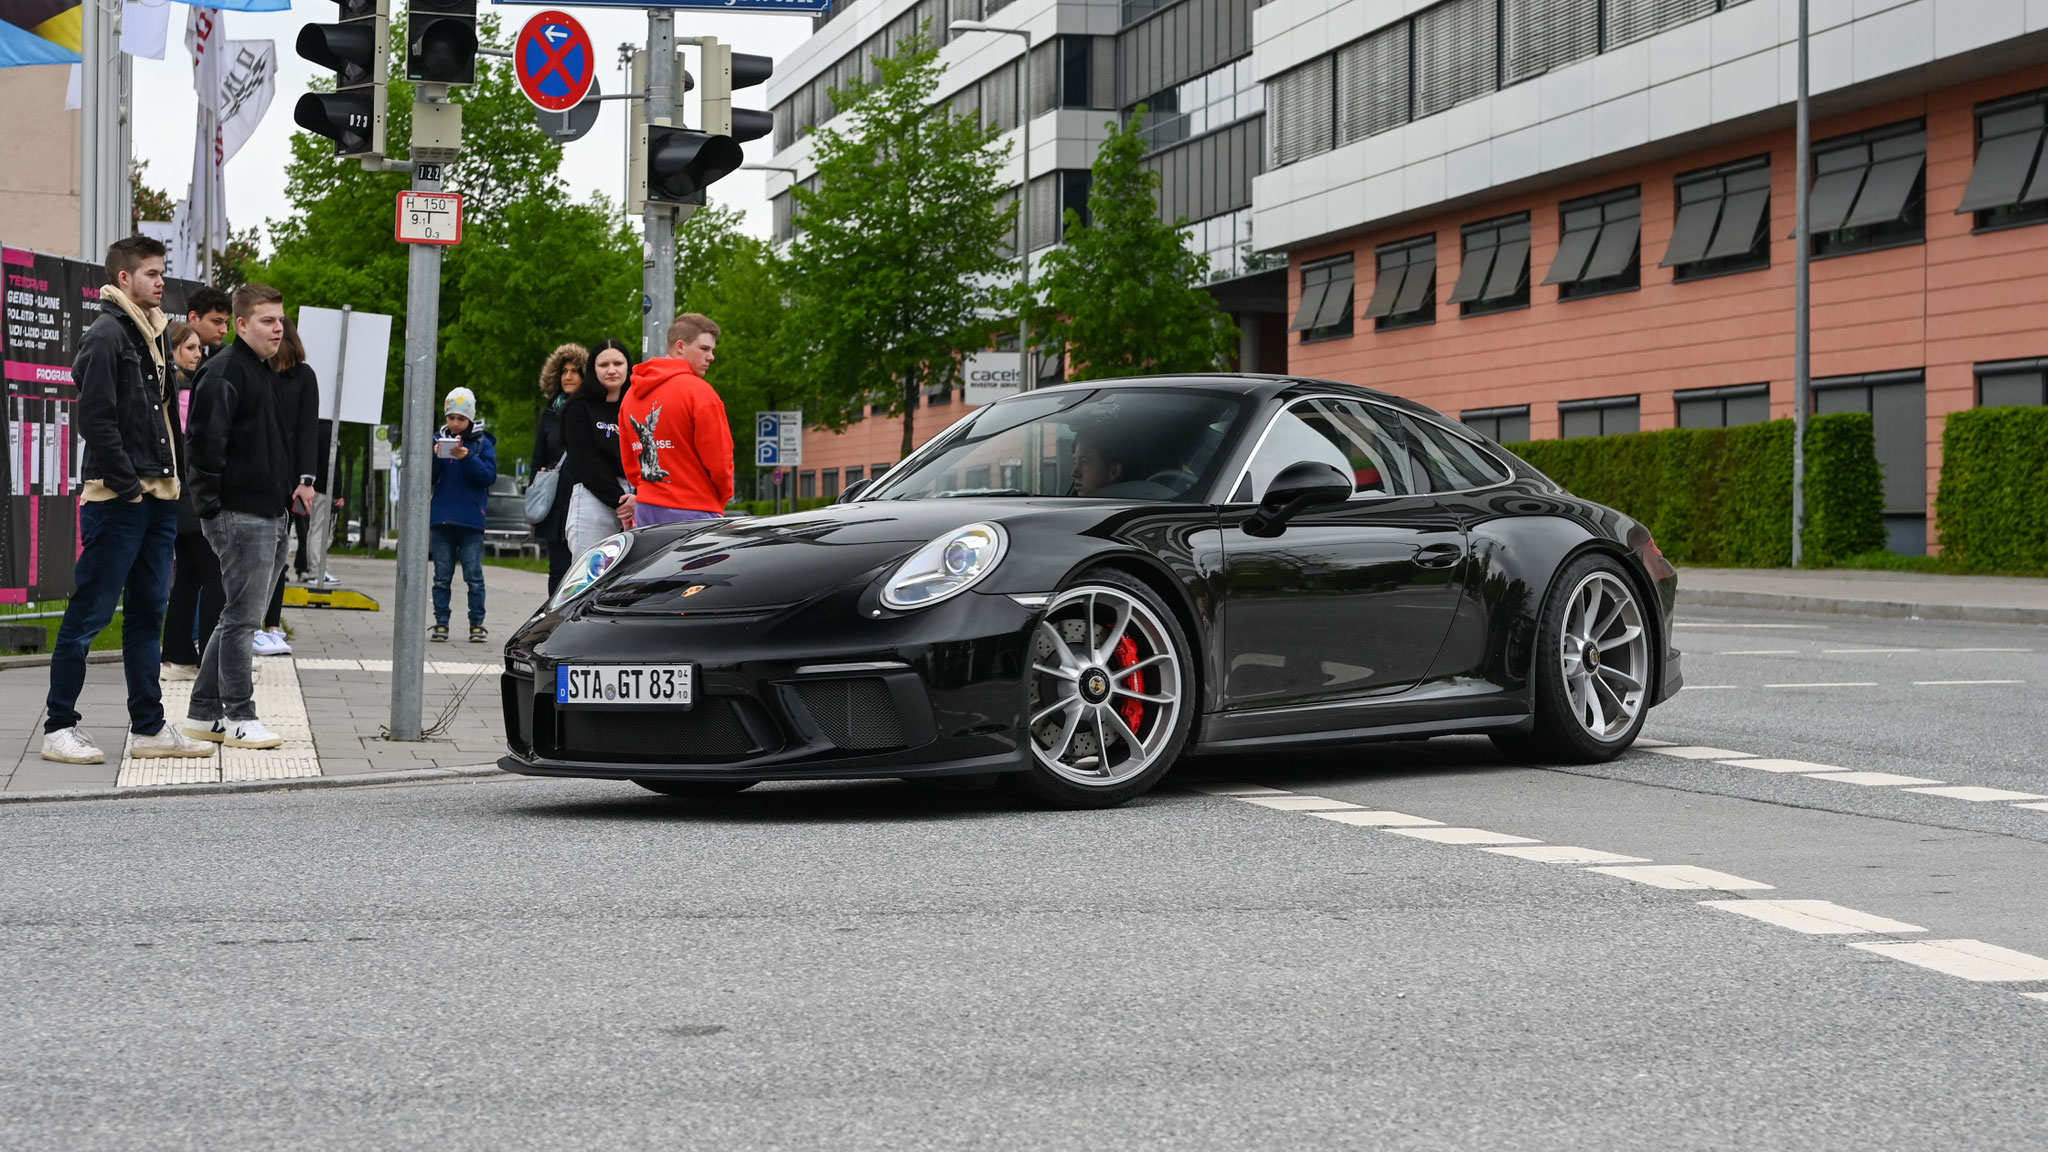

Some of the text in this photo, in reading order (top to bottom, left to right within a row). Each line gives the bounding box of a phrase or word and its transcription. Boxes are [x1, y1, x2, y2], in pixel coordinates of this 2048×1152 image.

[420, 166, 440, 180] 122
[406, 197, 446, 210] H 150
[37, 295, 60, 310] ALPINE
[38, 312, 55, 325] TESLA
[41, 329, 60, 341] LEXUS
[761, 421, 773, 437] P
[761, 447, 773, 463] P
[677, 669, 688, 678] 04
[569, 669, 675, 699] STA GT 83
[678, 690, 688, 699] 10
